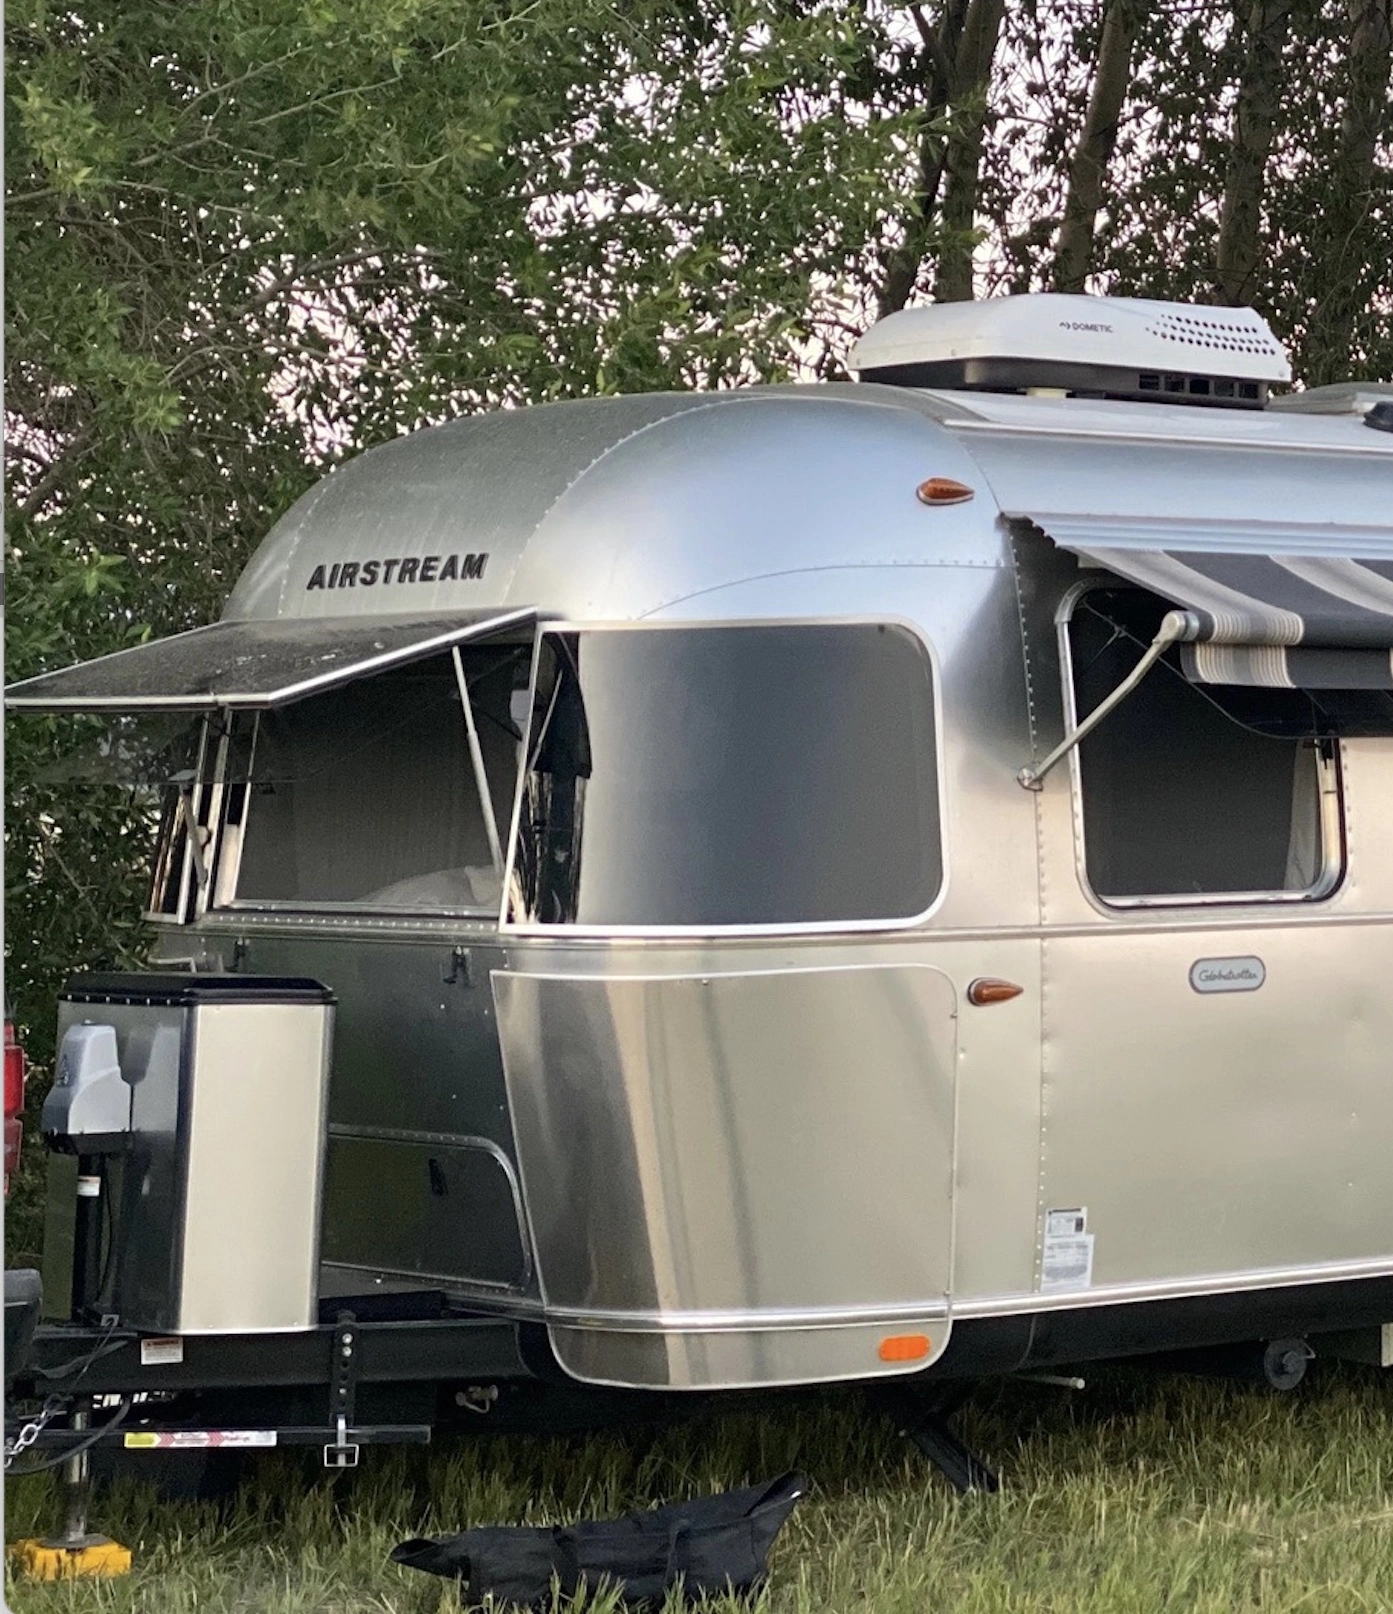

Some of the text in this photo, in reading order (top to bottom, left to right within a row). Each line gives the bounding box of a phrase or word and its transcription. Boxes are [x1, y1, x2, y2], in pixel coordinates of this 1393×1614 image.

[1072, 322, 1113, 333] DOMETIC
[306, 552, 490, 591] AIRSTREAM
[1199, 968, 1258, 982] Globetrotter
